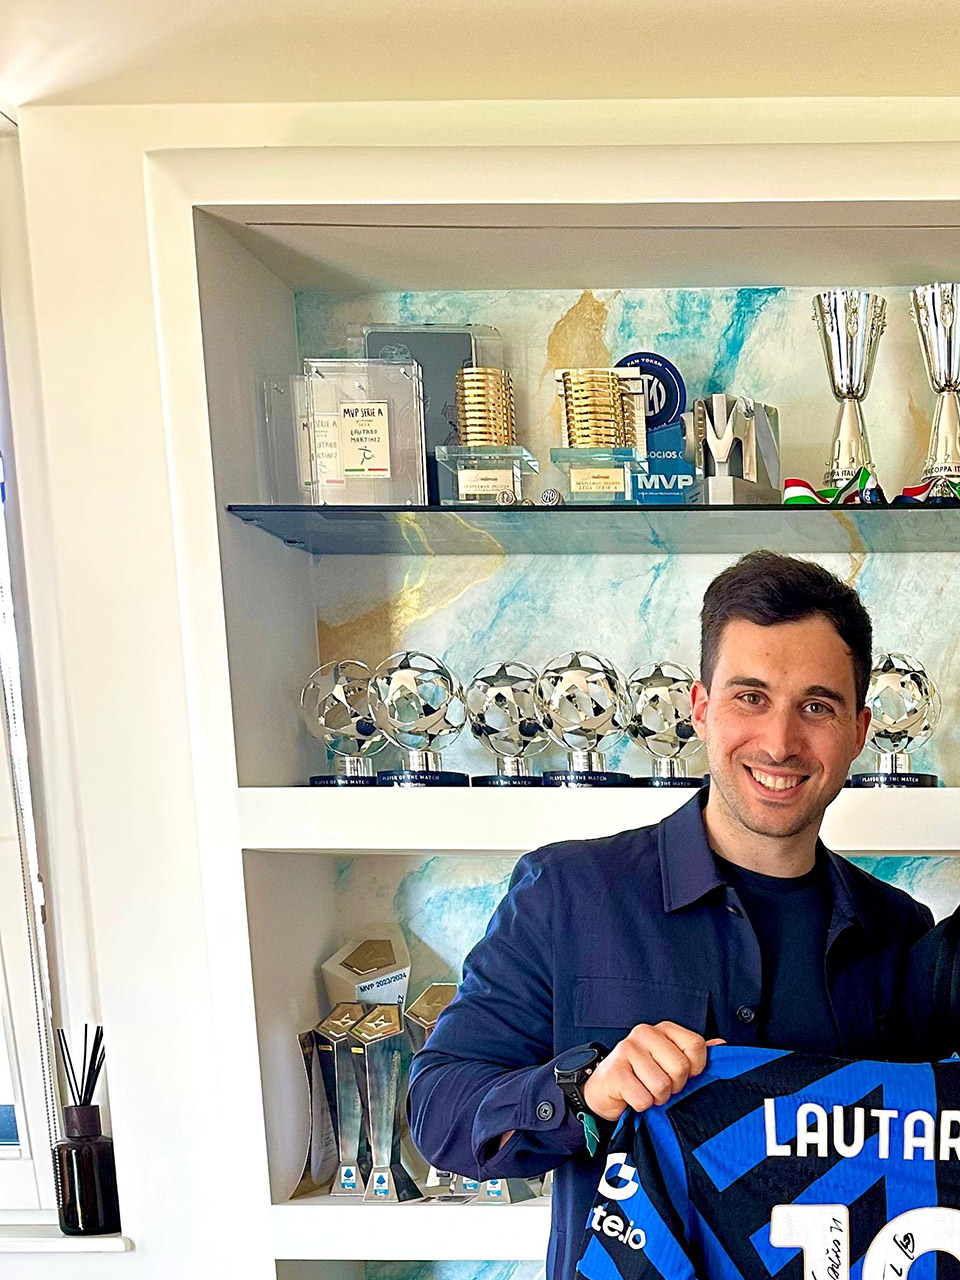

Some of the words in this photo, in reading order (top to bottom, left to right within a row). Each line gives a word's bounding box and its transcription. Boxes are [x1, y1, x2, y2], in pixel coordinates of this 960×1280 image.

[626, 359, 640, 367] FAN
[641, 358, 663, 367] TOKEN
[343, 407, 359, 418] MVP
[361, 407, 376, 417] SERIE
[377, 408, 384, 417] A
[637, 474, 694, 490] MVP
[360, 983, 375, 993] MVP
[376, 972, 407, 988] 2023/2024
[591, 1205, 647, 1250] te.io
